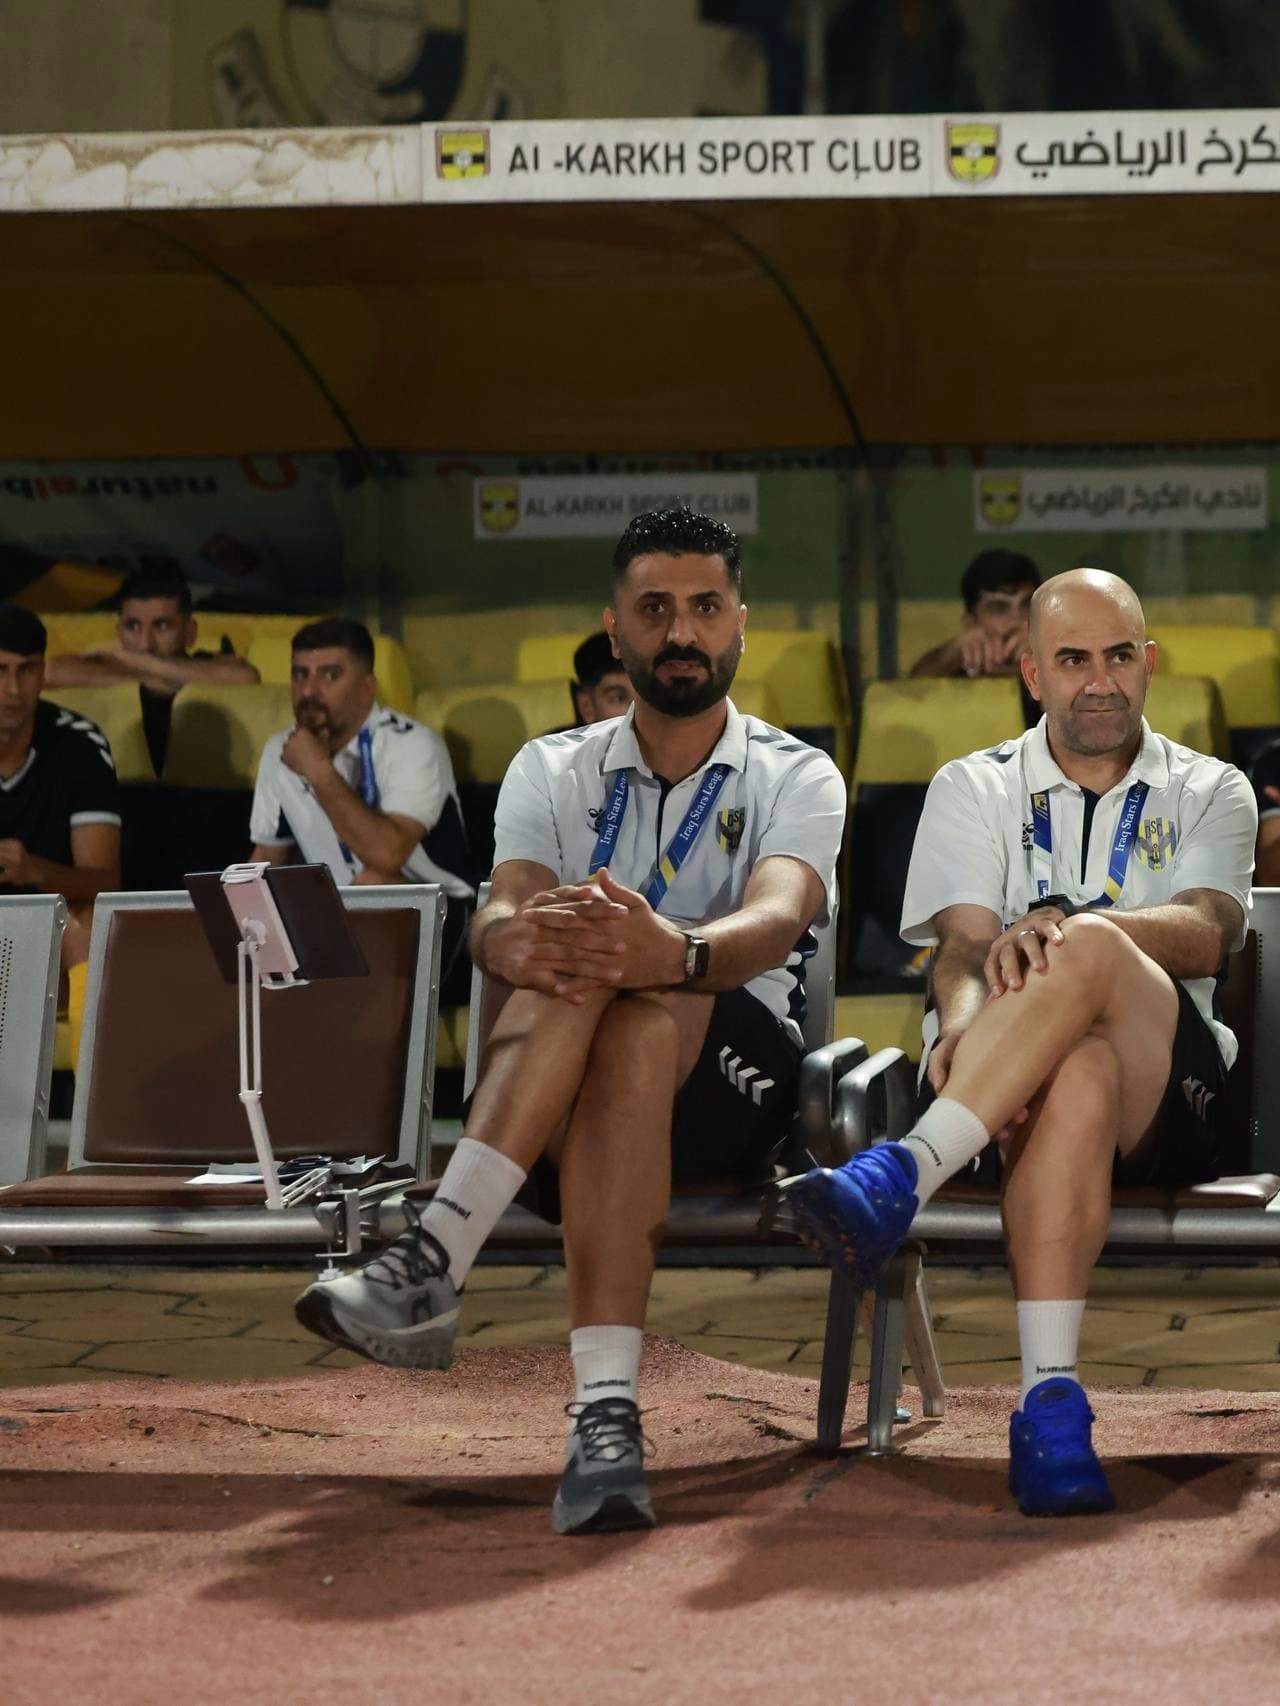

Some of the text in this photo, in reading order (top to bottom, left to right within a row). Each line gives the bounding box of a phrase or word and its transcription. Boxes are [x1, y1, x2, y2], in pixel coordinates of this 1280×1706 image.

[697, 140, 816, 175] SPORT
[826, 138, 923, 176] CLUB
[1015, 128, 1187, 179] الرياضي
[525, 494, 625, 517] AL-KARKH
[698, 493, 752, 517] CLUB
[1026, 482, 1262, 518] نادي الكرخ الرياضي
[606, 796, 623, 823] Stars
[689, 795, 710, 821] Stars
[1121, 805, 1138, 830] Stars
[600, 823, 618, 845] Iraq
[680, 819, 700, 841] Iraq
[1115, 831, 1132, 852] Iraq
